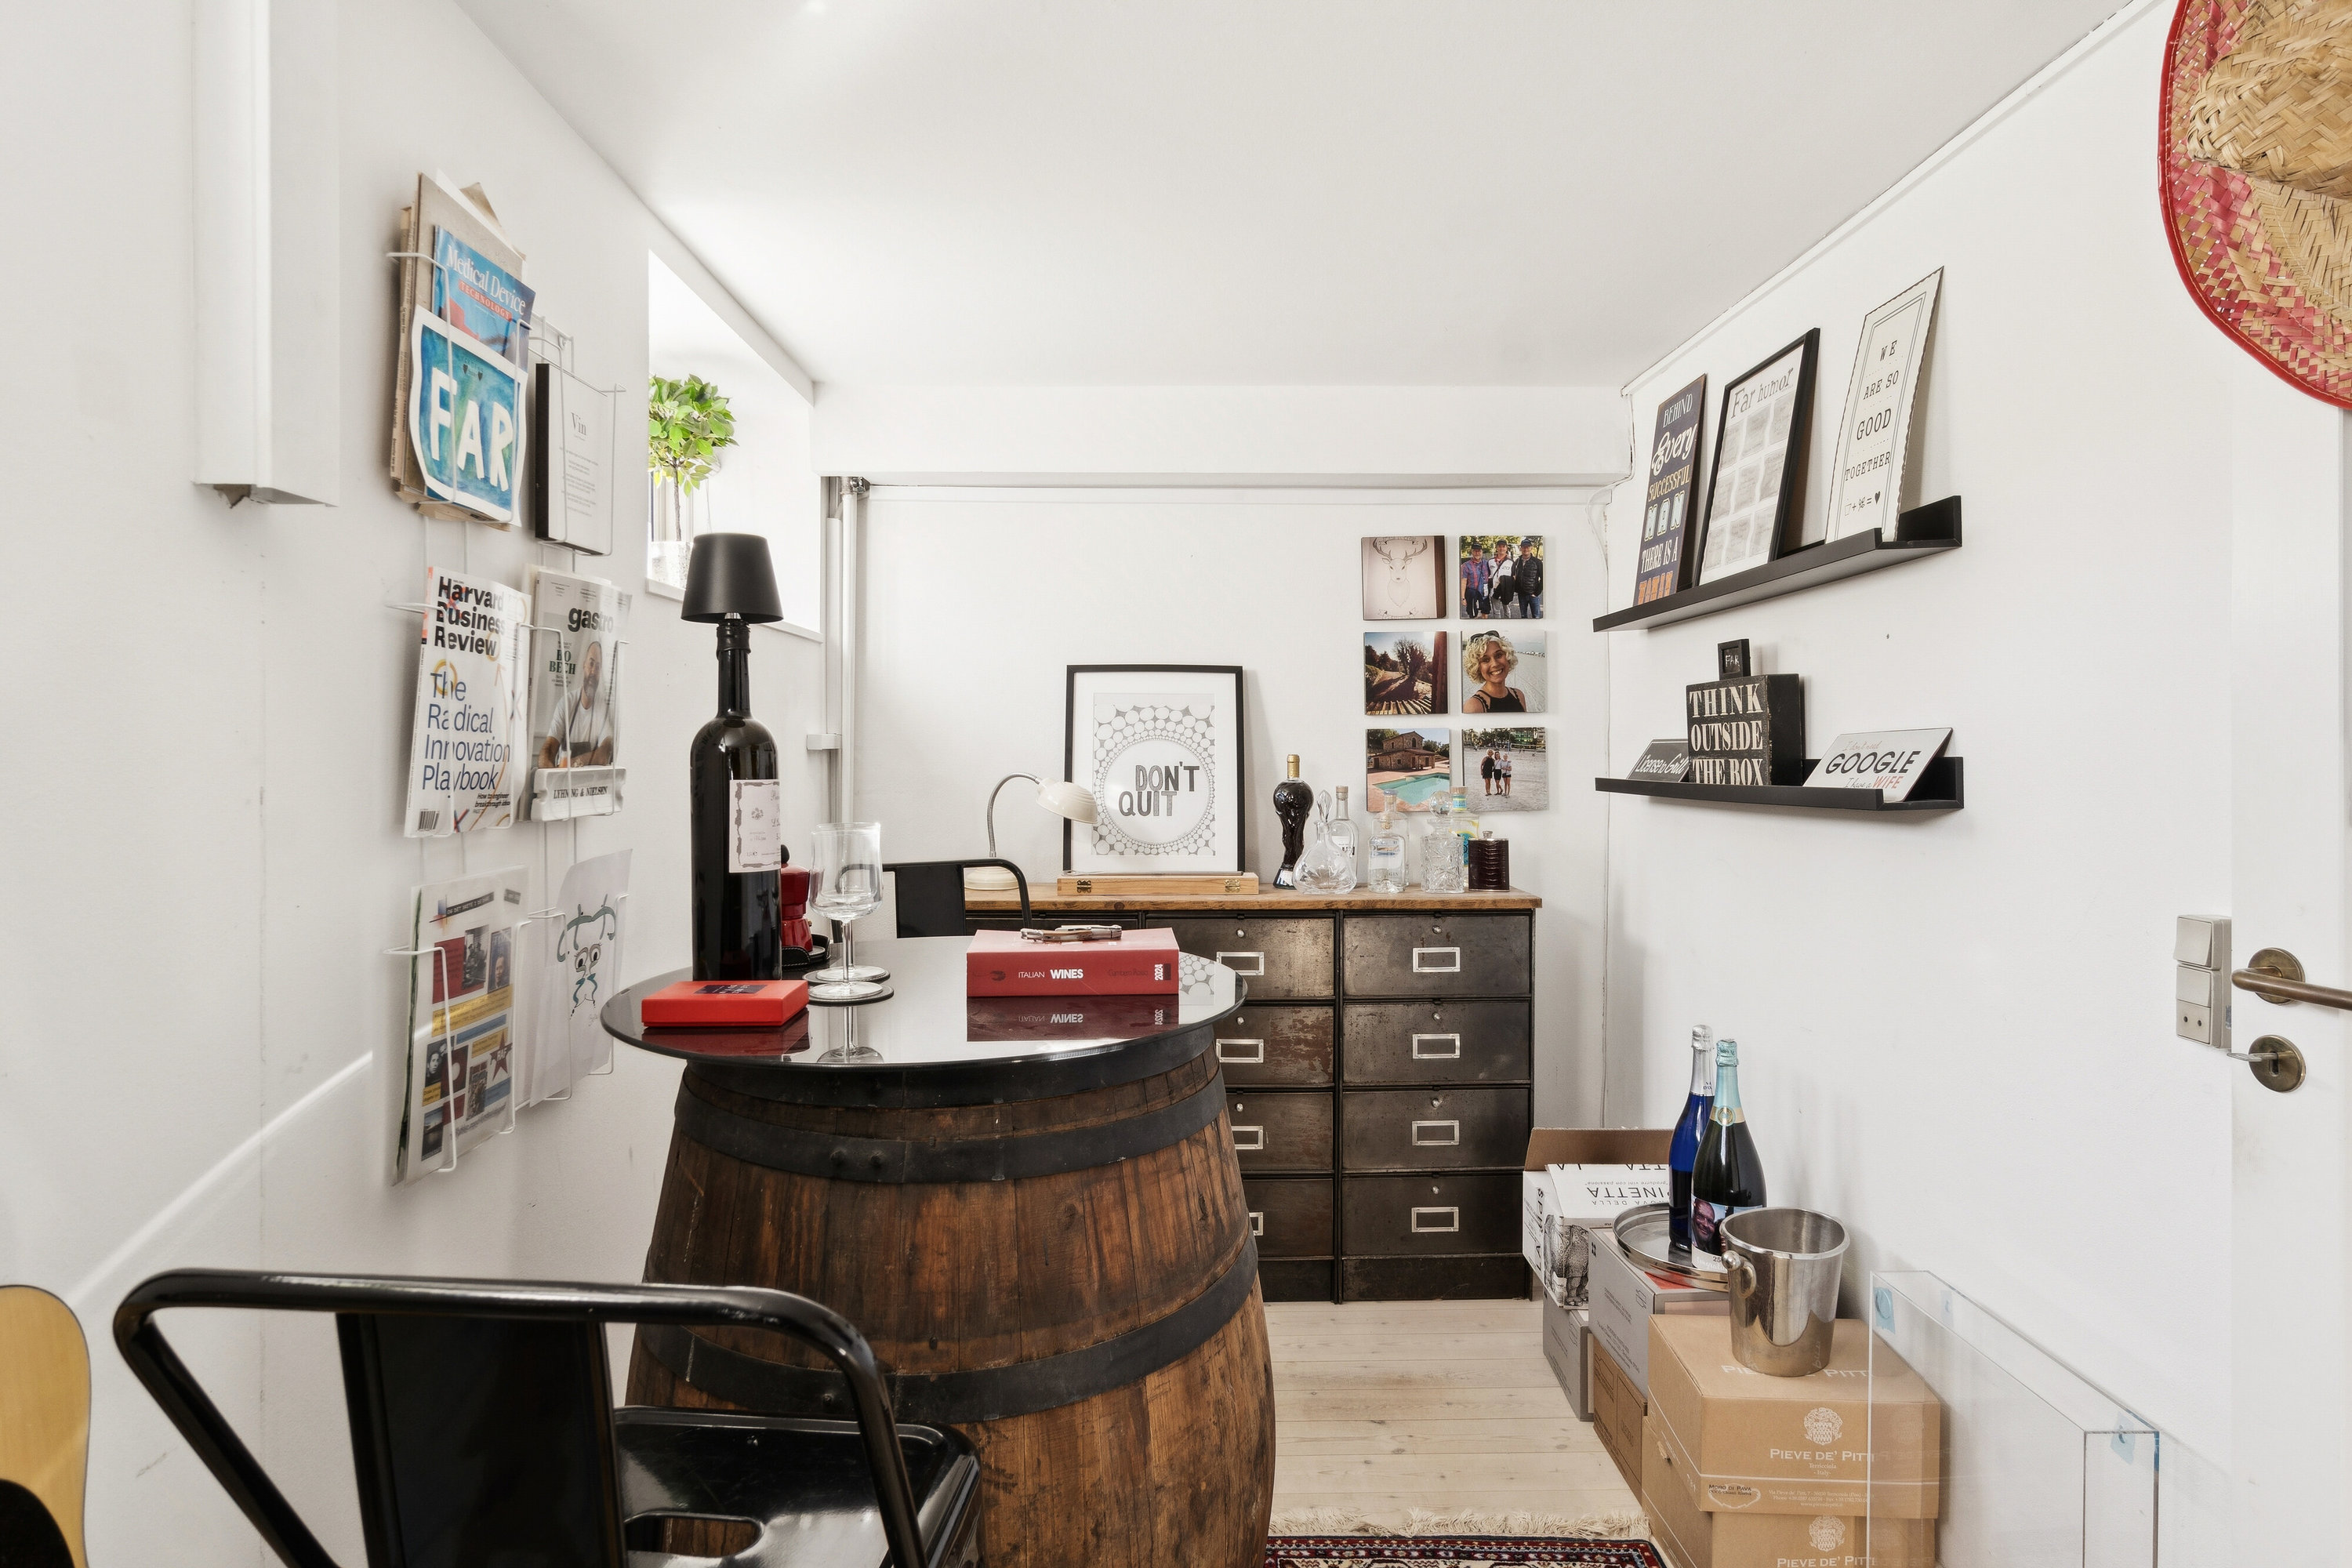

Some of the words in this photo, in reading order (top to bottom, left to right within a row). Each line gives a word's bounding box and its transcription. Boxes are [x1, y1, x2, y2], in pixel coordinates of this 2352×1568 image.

[446, 244, 490, 292] Medical
[490, 275, 526, 315] Device
[460, 281, 511, 322] TECHNOLOGY
[1731, 387, 1755, 419] Far
[1757, 366, 1794, 402] humor
[1863, 379, 1882, 400] ARE
[1886, 370, 1899, 389] SO
[571, 411, 586, 435] Vin
[1662, 394, 1693, 428] BEHIND
[1857, 408, 1892, 441] GOOD
[430, 366, 514, 492] FAR
[1651, 423, 1698, 477] Every
[1844, 451, 1890, 481] TOGETHER
[1648, 465, 1691, 503] SUCCESSFUL
[1644, 490, 1685, 542] MAN
[1640, 542, 1661, 574] THERE
[1663, 542, 1672, 566] IS
[1671, 537, 1679, 561] A
[438, 575, 505, 612] Harvard
[1639, 572, 1673, 604] WOMAN
[436, 601, 506, 637] Business
[568, 608, 614, 633] gastro
[434, 625, 497, 656] Review
[1725, 654, 1740, 667] FAR
[430, 671, 466, 701] The
[1689, 683, 1763, 717] THINK
[428, 703, 493, 734] Radical
[1690, 720, 1762, 751] OUTSIDE
[1866, 740, 1882, 750] need
[1135, 761, 1200, 792] DON'T
[1635, 753, 1661, 773] License
[1692, 758, 1725, 784] THE
[1729, 757, 1763, 786] BOX
[1825, 750, 1921, 774] GOOGLE
[554, 789, 579, 799] LYHNNG
[580, 788, 584, 797] &
[586, 786, 608, 796] NIELSEN
[1853, 778, 1865, 788] have
[1872, 775, 1904, 789] WIFE
[1118, 790, 1178, 816] QUIT
[1050, 968, 1083, 979] WINES
[1154, 964, 1163, 980] 2024
[1769, 1448, 1812, 1460] PIEVE
[1777, 1558, 1817, 1568] PIEVE
